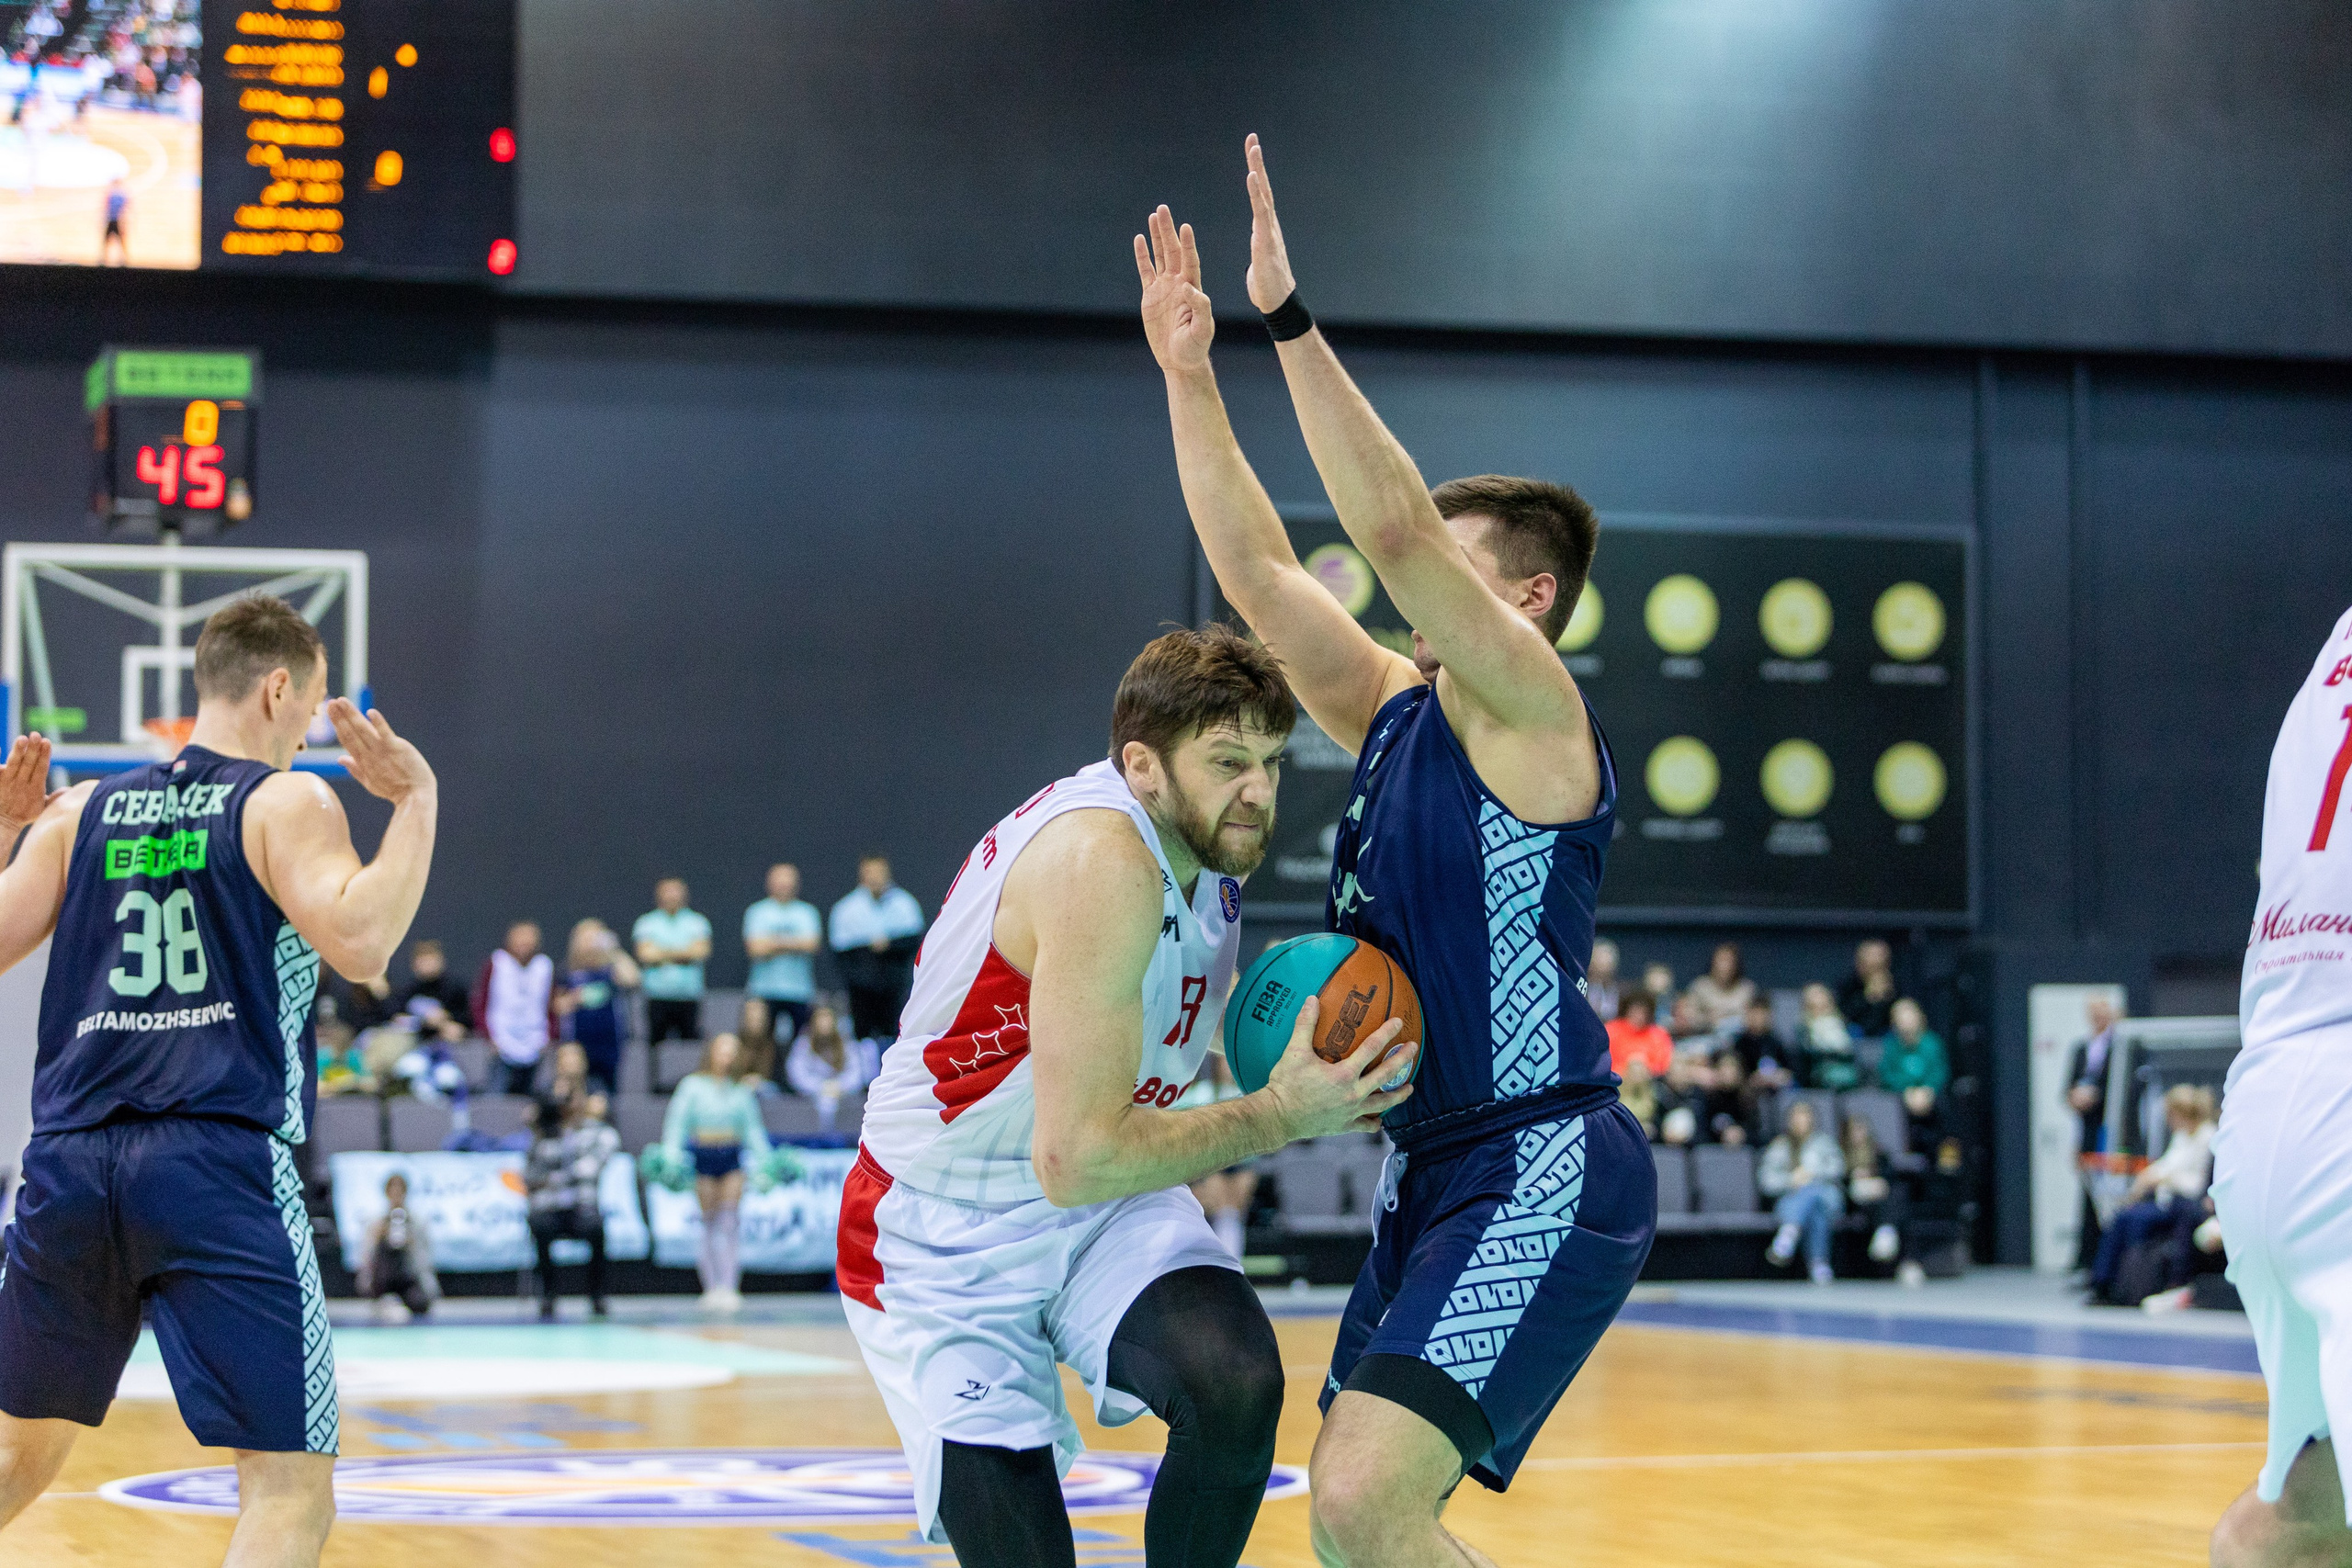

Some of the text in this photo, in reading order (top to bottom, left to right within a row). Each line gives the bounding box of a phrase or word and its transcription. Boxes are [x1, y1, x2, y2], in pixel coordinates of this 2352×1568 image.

[136, 445, 226, 509] 45
[108, 887, 209, 998] 38
[2247, 898, 2352, 949] Милан
[1251, 980, 1283, 1023] FIBA
[1266, 987, 1292, 1027] APPROVED
